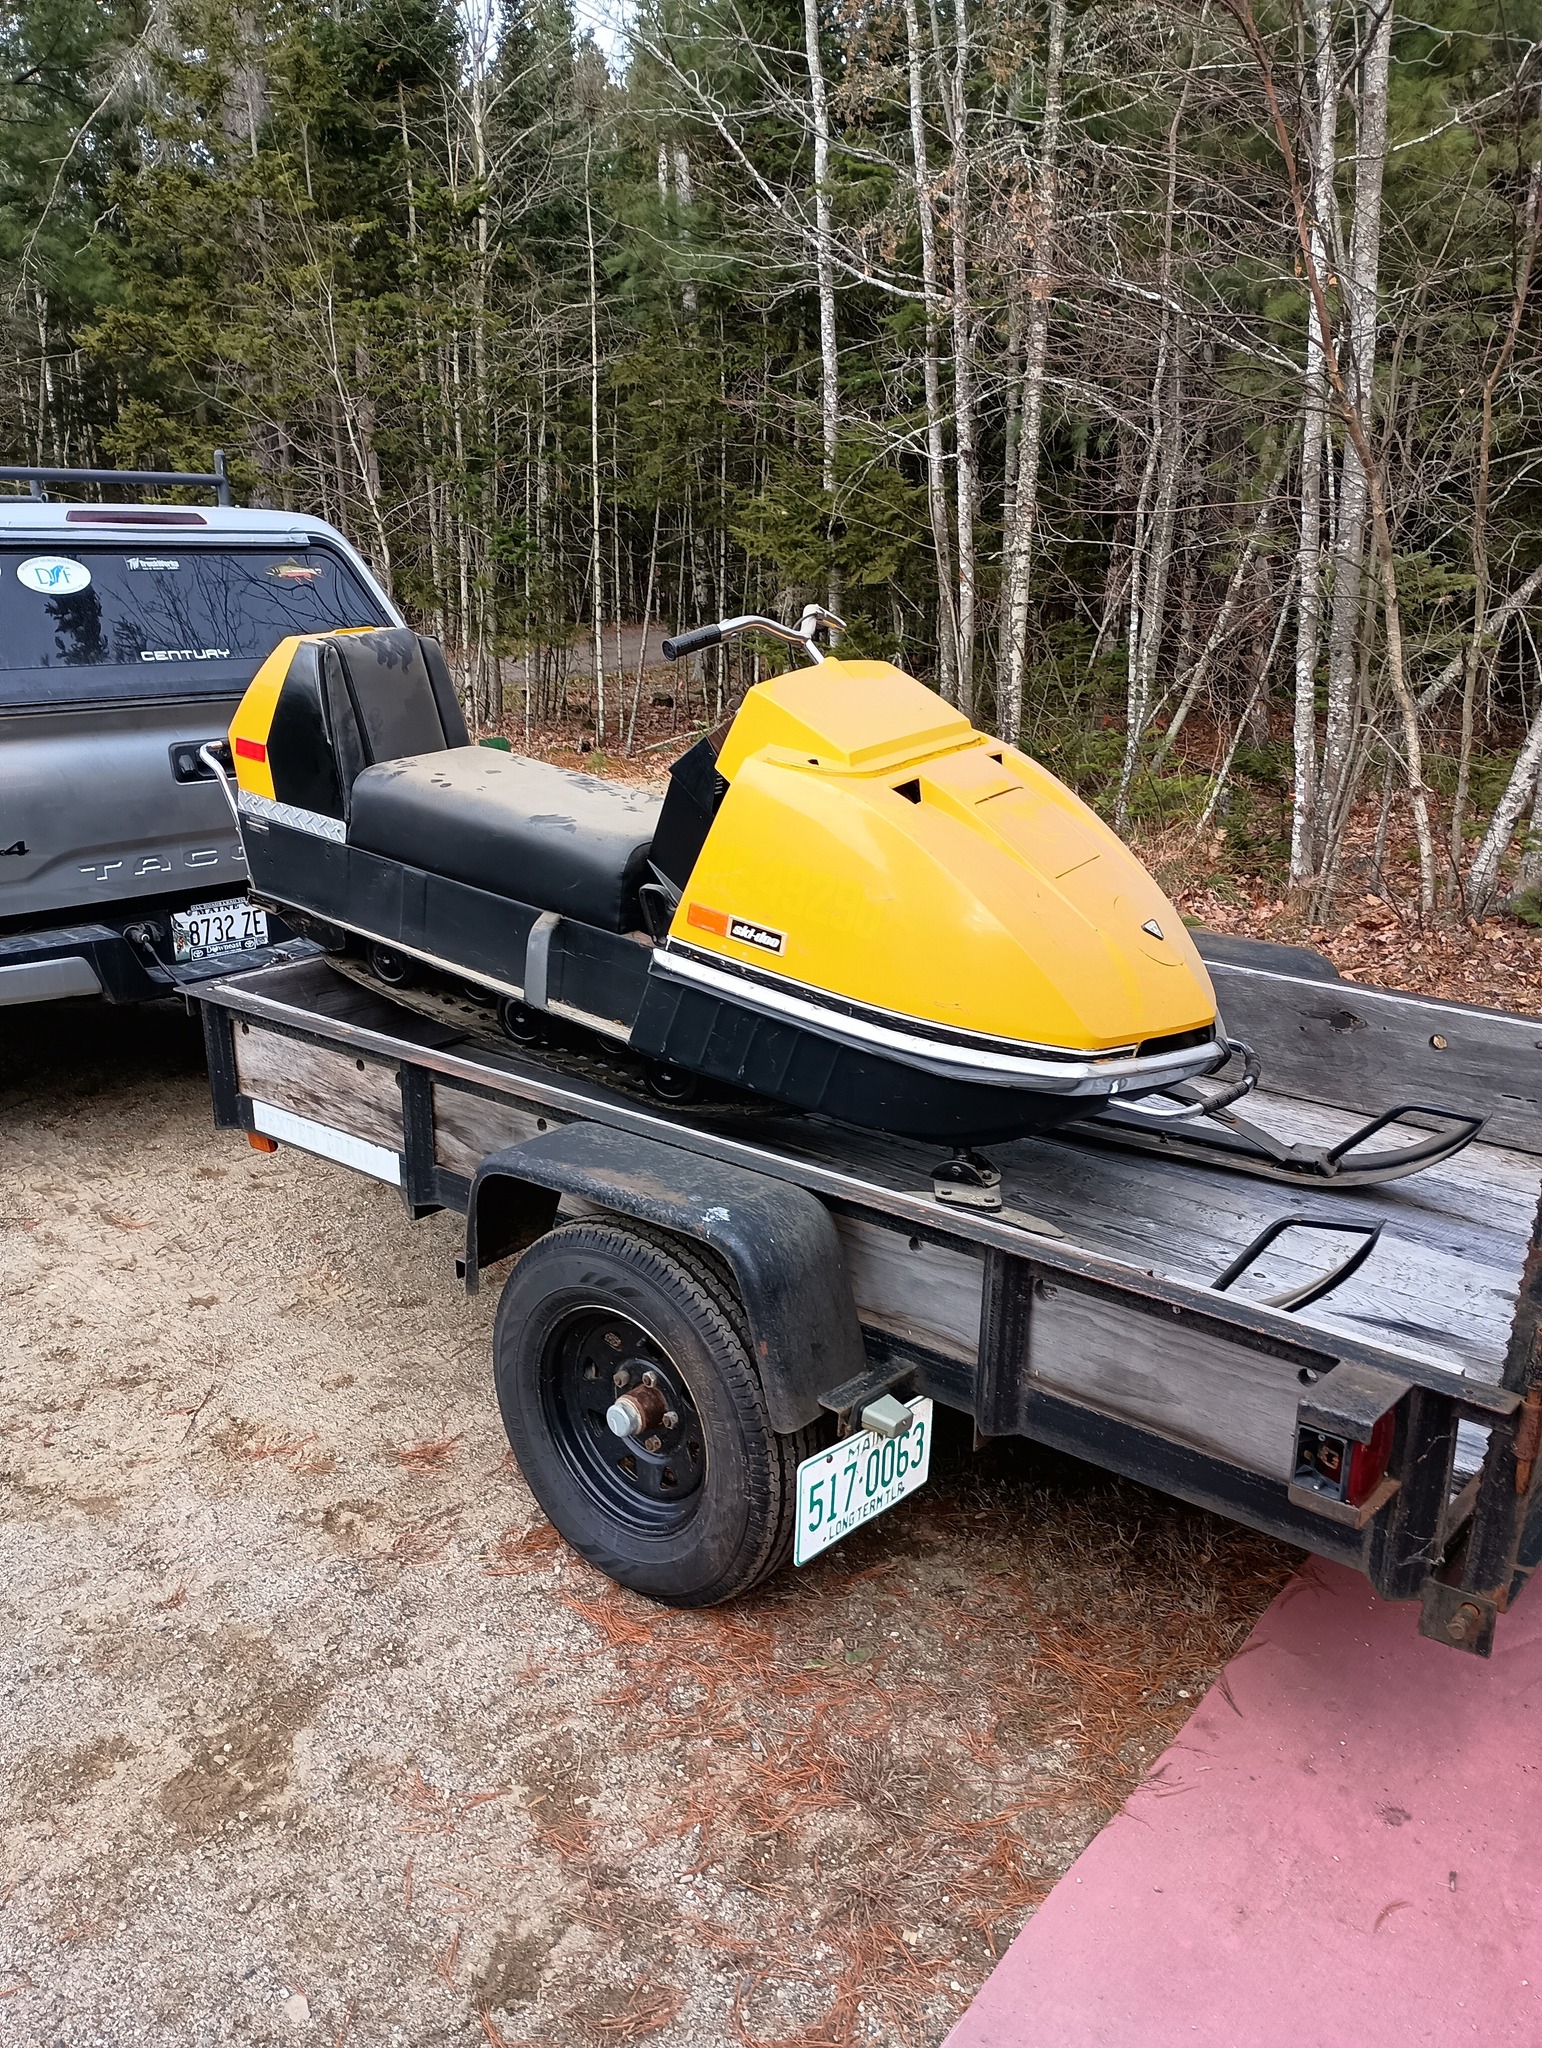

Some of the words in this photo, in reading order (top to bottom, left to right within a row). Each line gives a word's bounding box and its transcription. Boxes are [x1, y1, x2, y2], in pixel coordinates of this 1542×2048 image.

[140, 648, 230, 662] CENTURY
[197, 904, 239, 916] MAINE
[189, 915, 235, 946] 8732
[241, 910, 264, 938] ZE
[731, 924, 781, 948] ski-doo
[847, 1431, 888, 1463] MAIN
[828, 1512, 855, 1540] LONG
[856, 1496, 883, 1521] TERM
